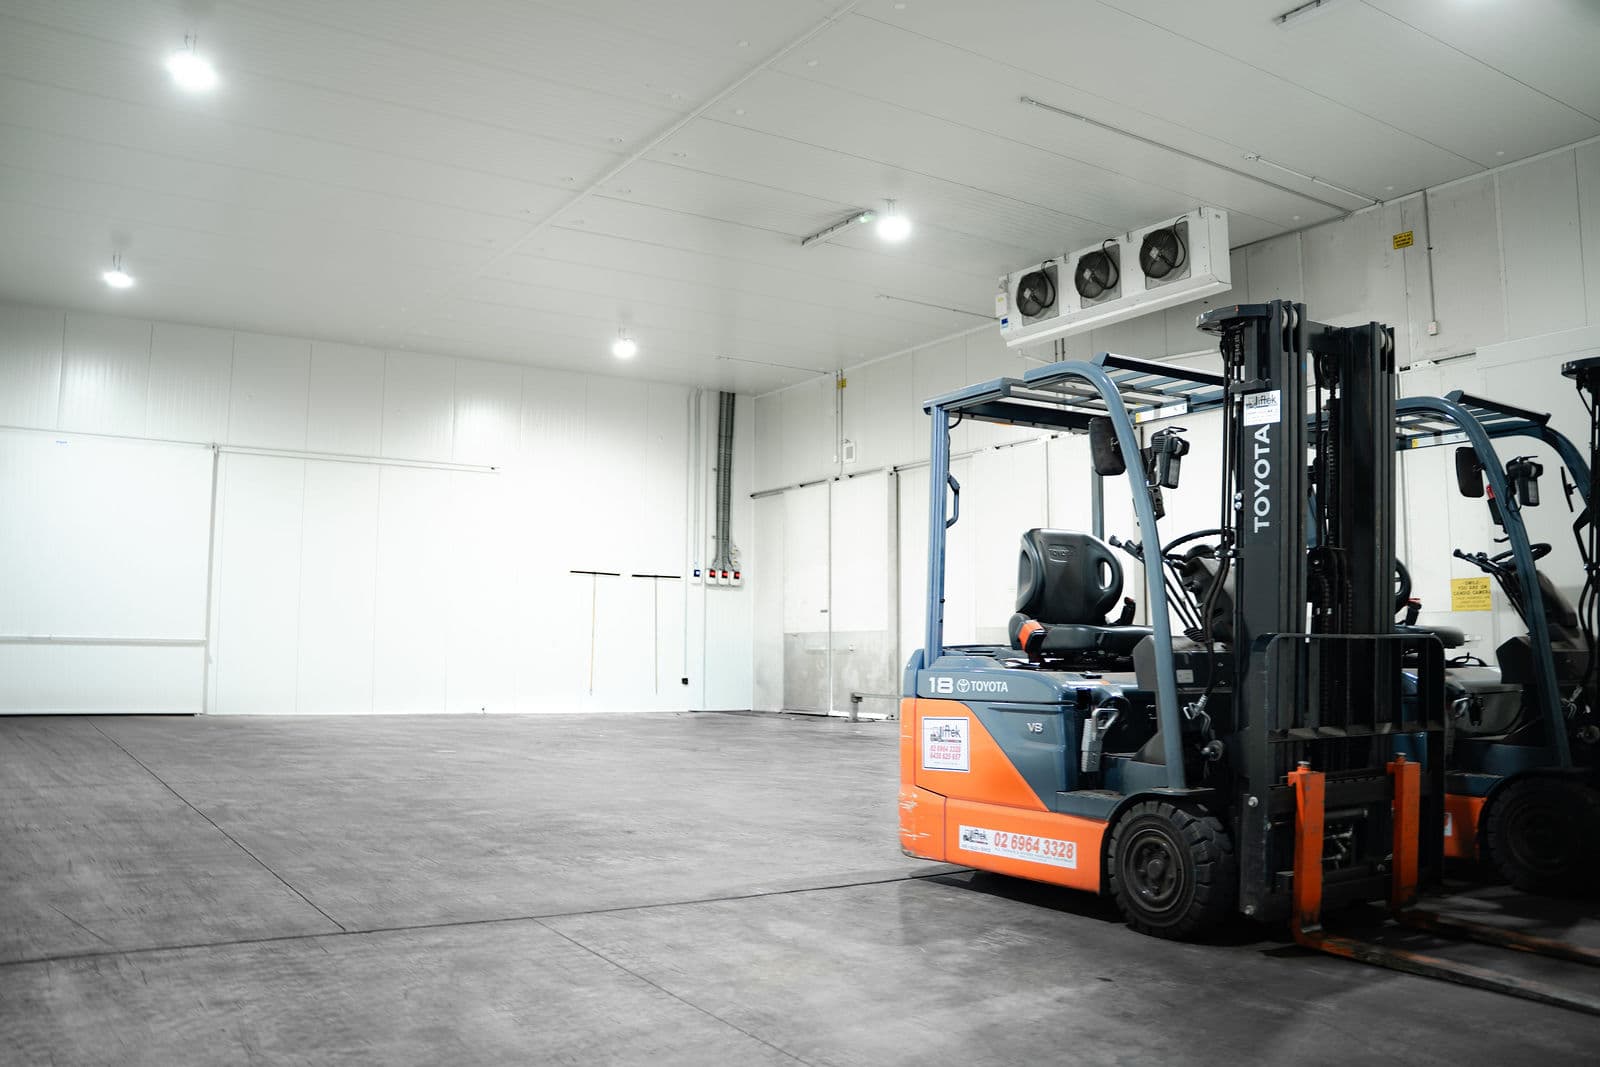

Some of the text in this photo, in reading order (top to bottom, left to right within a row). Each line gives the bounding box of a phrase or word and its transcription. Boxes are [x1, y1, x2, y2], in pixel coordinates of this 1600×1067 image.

[1254, 424, 1270, 533] TOYOTA
[929, 677, 1008, 694] 18 TOYOTA
[994, 832, 1008, 848] 02
[1011, 835, 1040, 853] 6964
[1043, 840, 1073, 859] 3328
